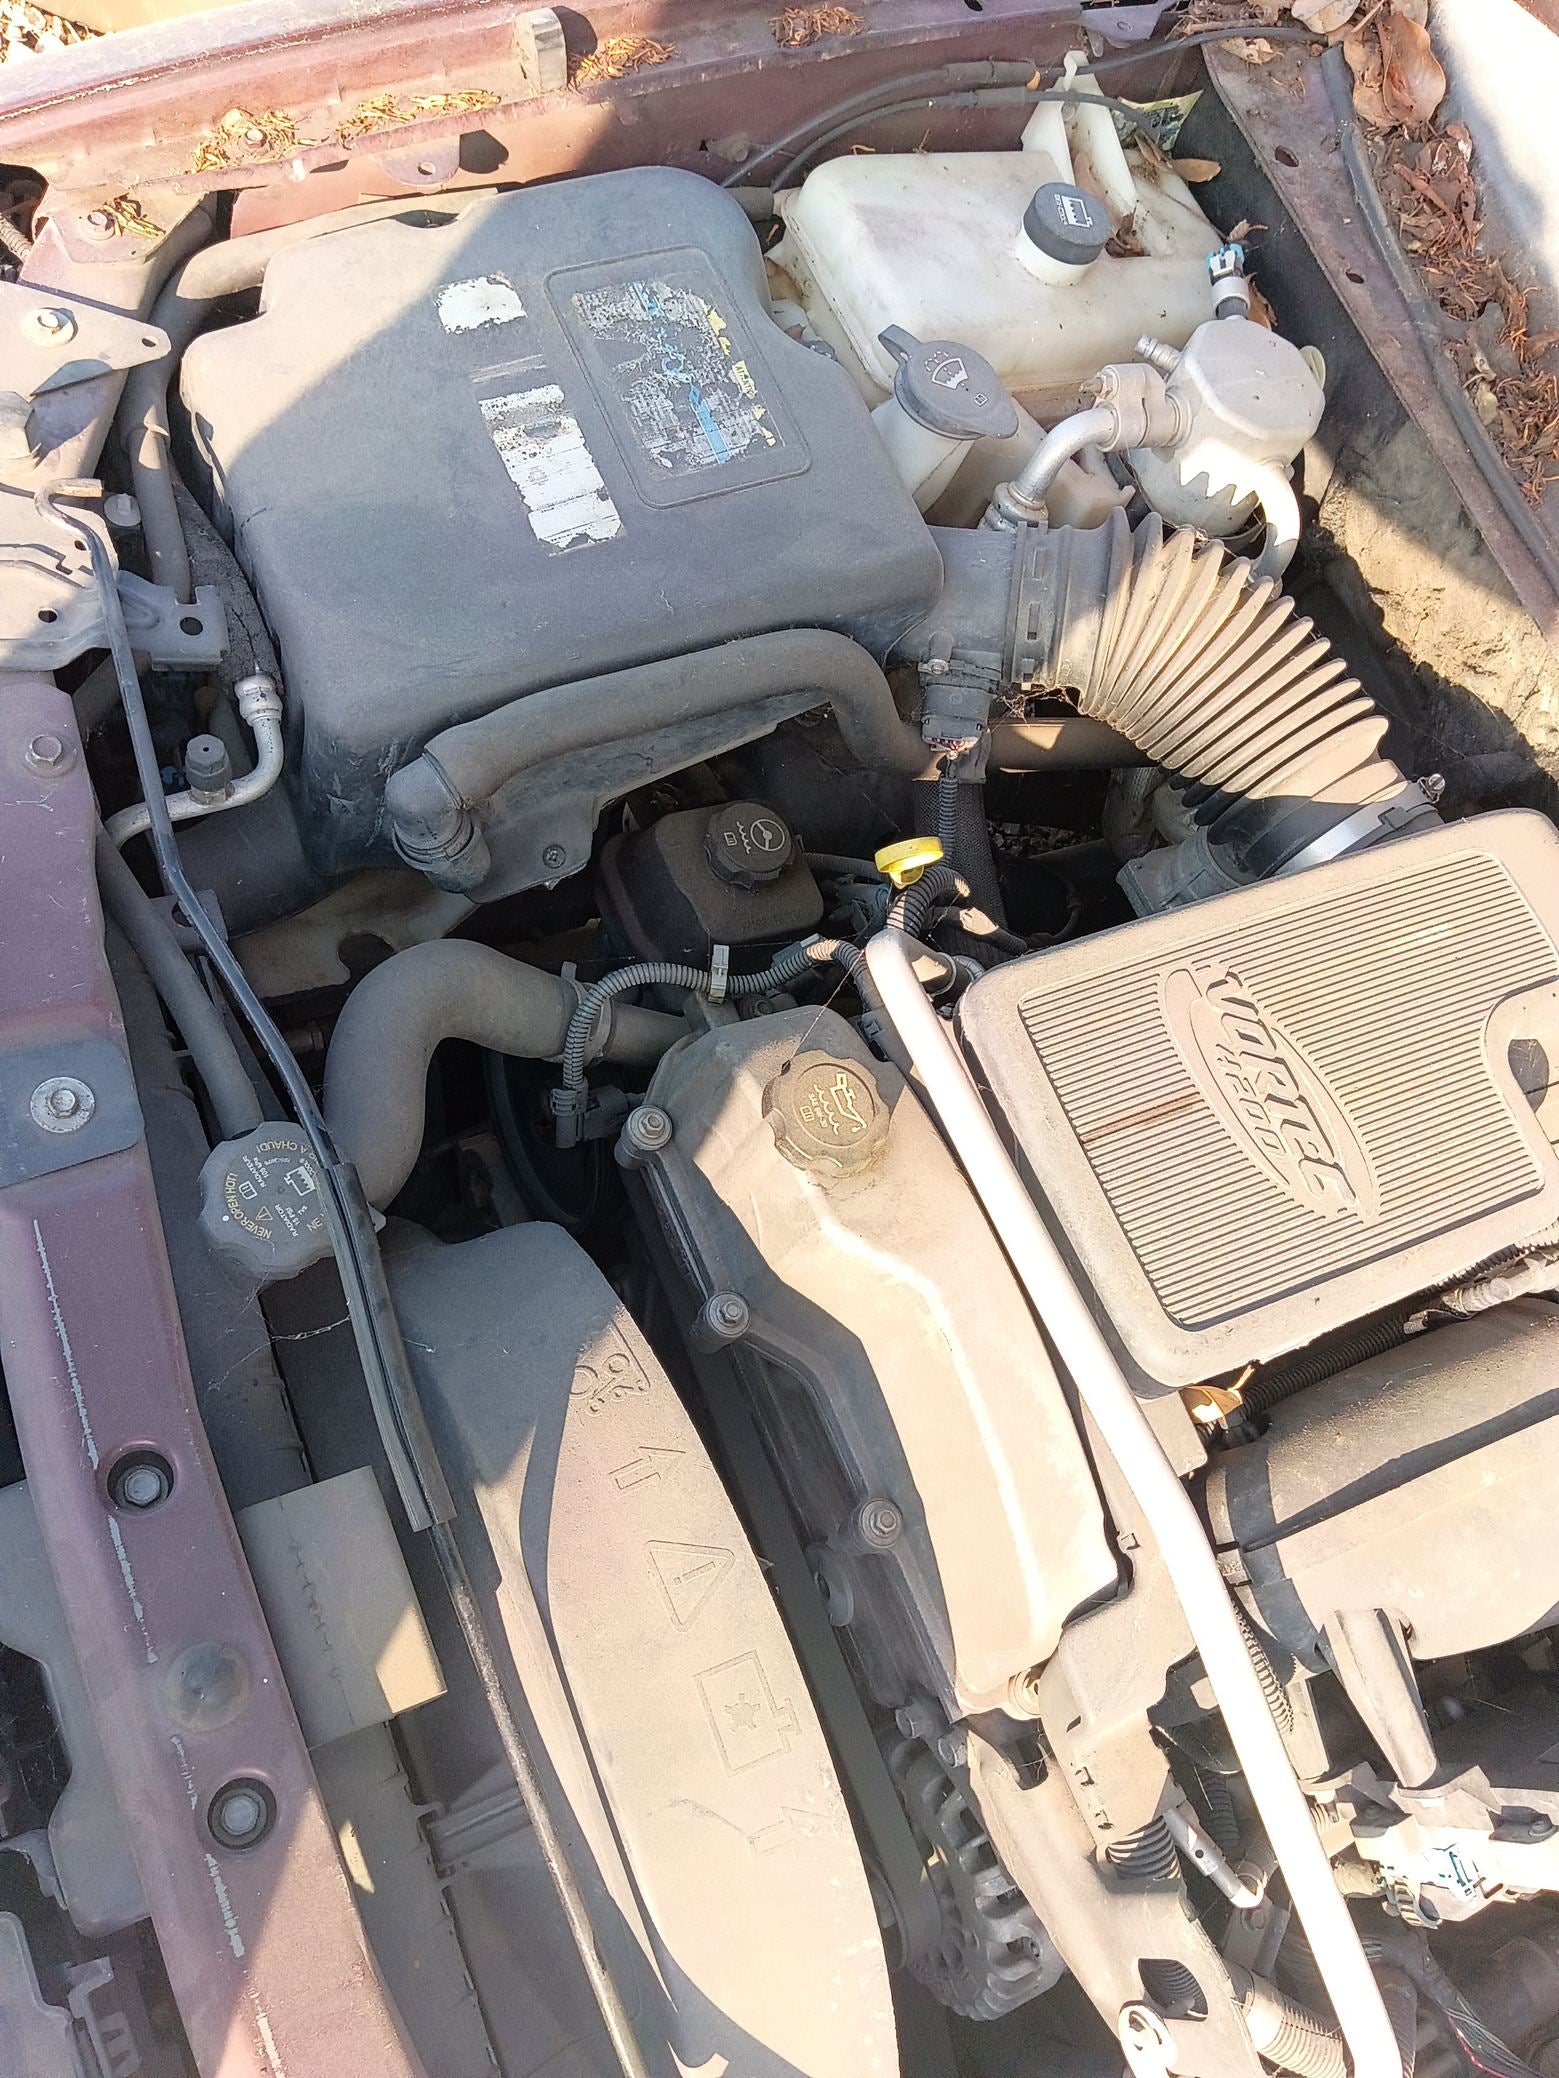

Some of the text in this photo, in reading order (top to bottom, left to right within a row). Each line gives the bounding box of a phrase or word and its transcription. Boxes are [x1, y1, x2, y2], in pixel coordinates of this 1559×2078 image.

[1206, 969, 1357, 1204] VORTEC
[1215, 1043, 1288, 1157] 4200
[226, 1195, 246, 1219] OPEN
[274, 1203, 299, 1237] RADIATOR
[240, 1216, 272, 1239] NEVER
